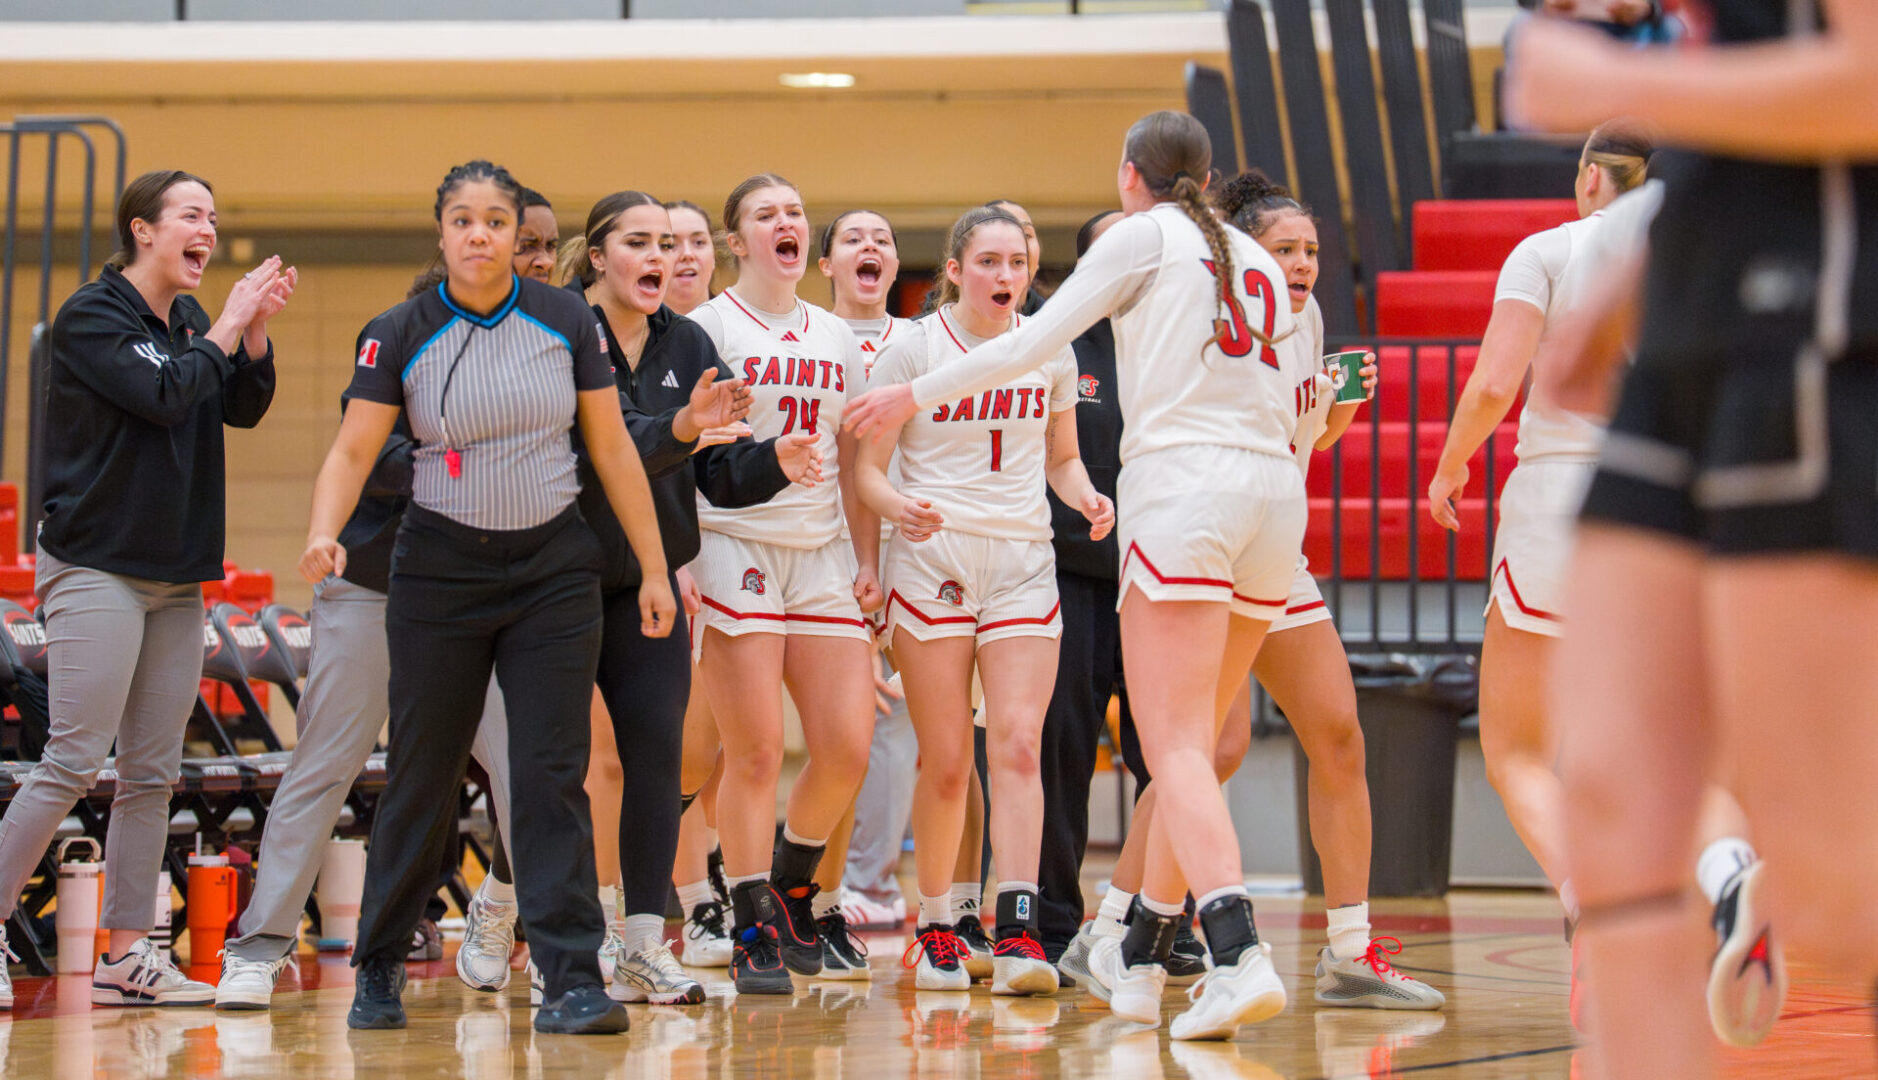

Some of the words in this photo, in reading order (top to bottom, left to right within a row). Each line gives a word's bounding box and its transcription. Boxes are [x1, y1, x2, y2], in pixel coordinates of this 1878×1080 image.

[742, 356, 845, 392] SAINTS
[778, 395, 821, 436] 24
[932, 387, 1045, 422] SAINTS
[989, 429, 1002, 472] 1
